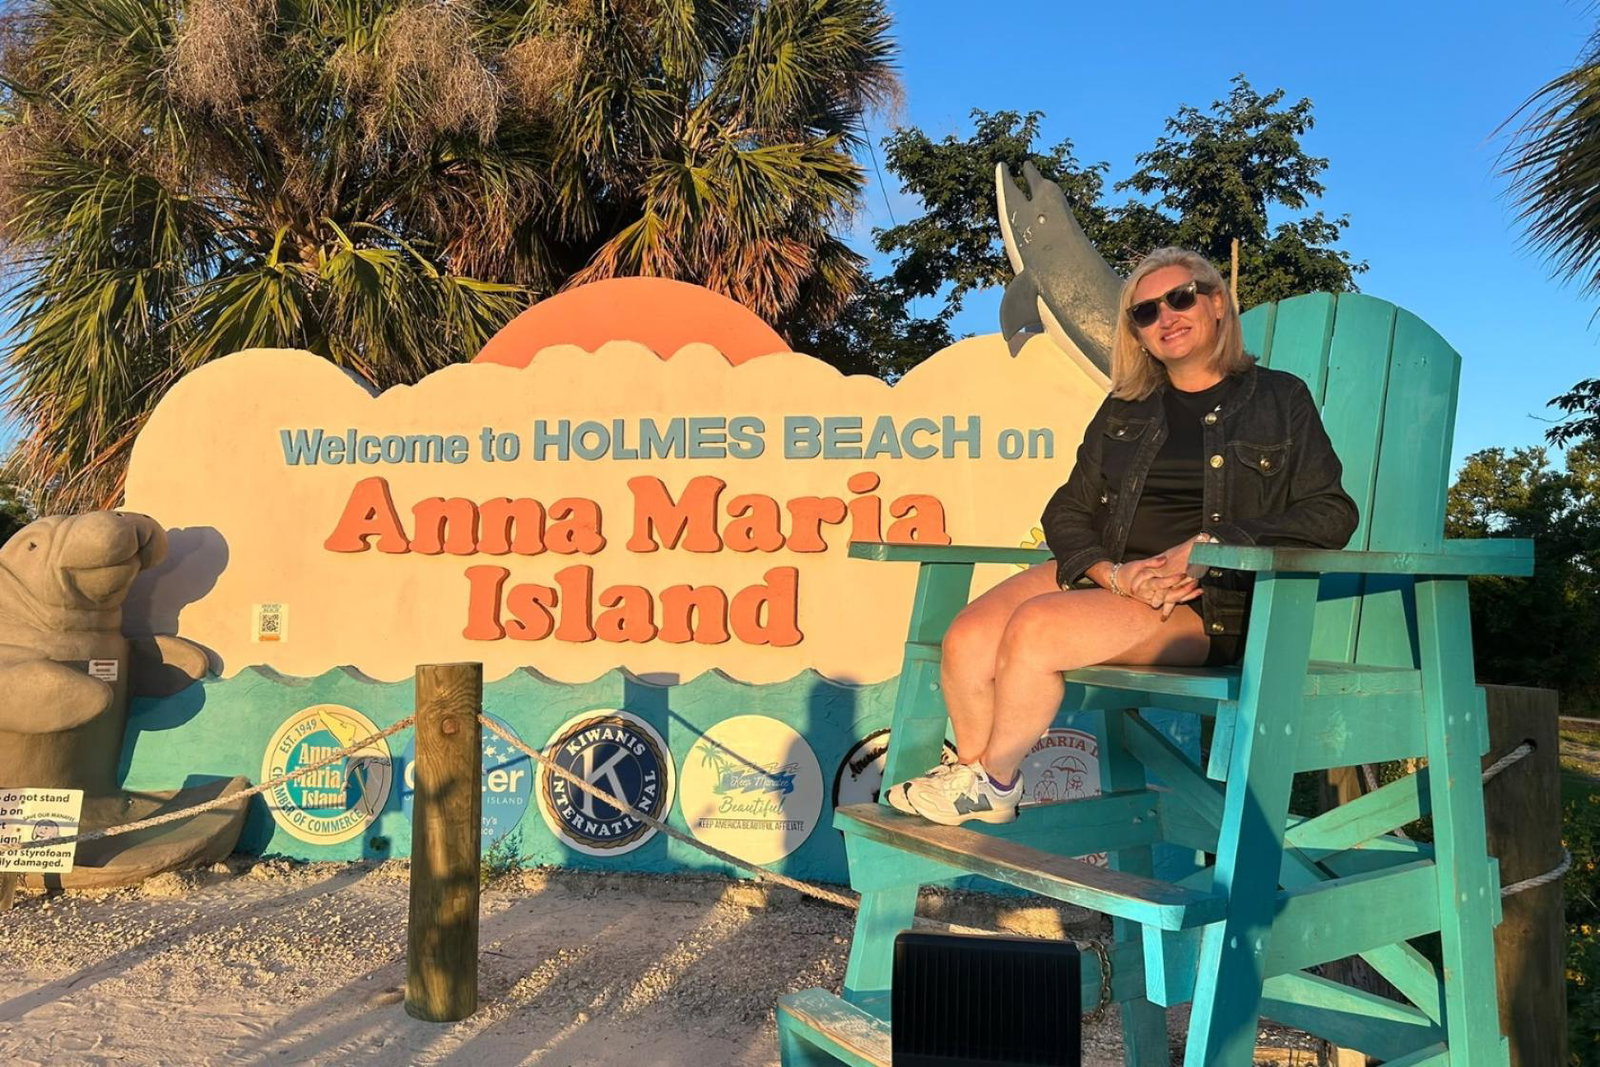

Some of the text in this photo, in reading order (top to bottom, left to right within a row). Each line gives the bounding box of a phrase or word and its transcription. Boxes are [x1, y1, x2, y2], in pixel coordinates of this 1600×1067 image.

[279, 415, 1054, 466] Welcome to HOLMES BEACH on
[323, 471, 952, 556] Anna Maria
[461, 563, 804, 647] Island
[280, 719, 317, 754] EST. 1949
[566, 728, 646, 756] KIWANIS
[1030, 736, 1087, 754] MARIA
[579, 744, 630, 819] K
[3, 793, 70, 803] do not stand
[301, 789, 347, 809] Island
[487, 796, 523, 805] ISLAND
[718, 796, 786, 818] Beautiful
[9, 808, 23, 816] on
[293, 812, 306, 827] OF
[308, 808, 363, 832] COMMERCE
[13, 859, 64, 869] damaged.
[20, 848, 72, 859] styrofoam
